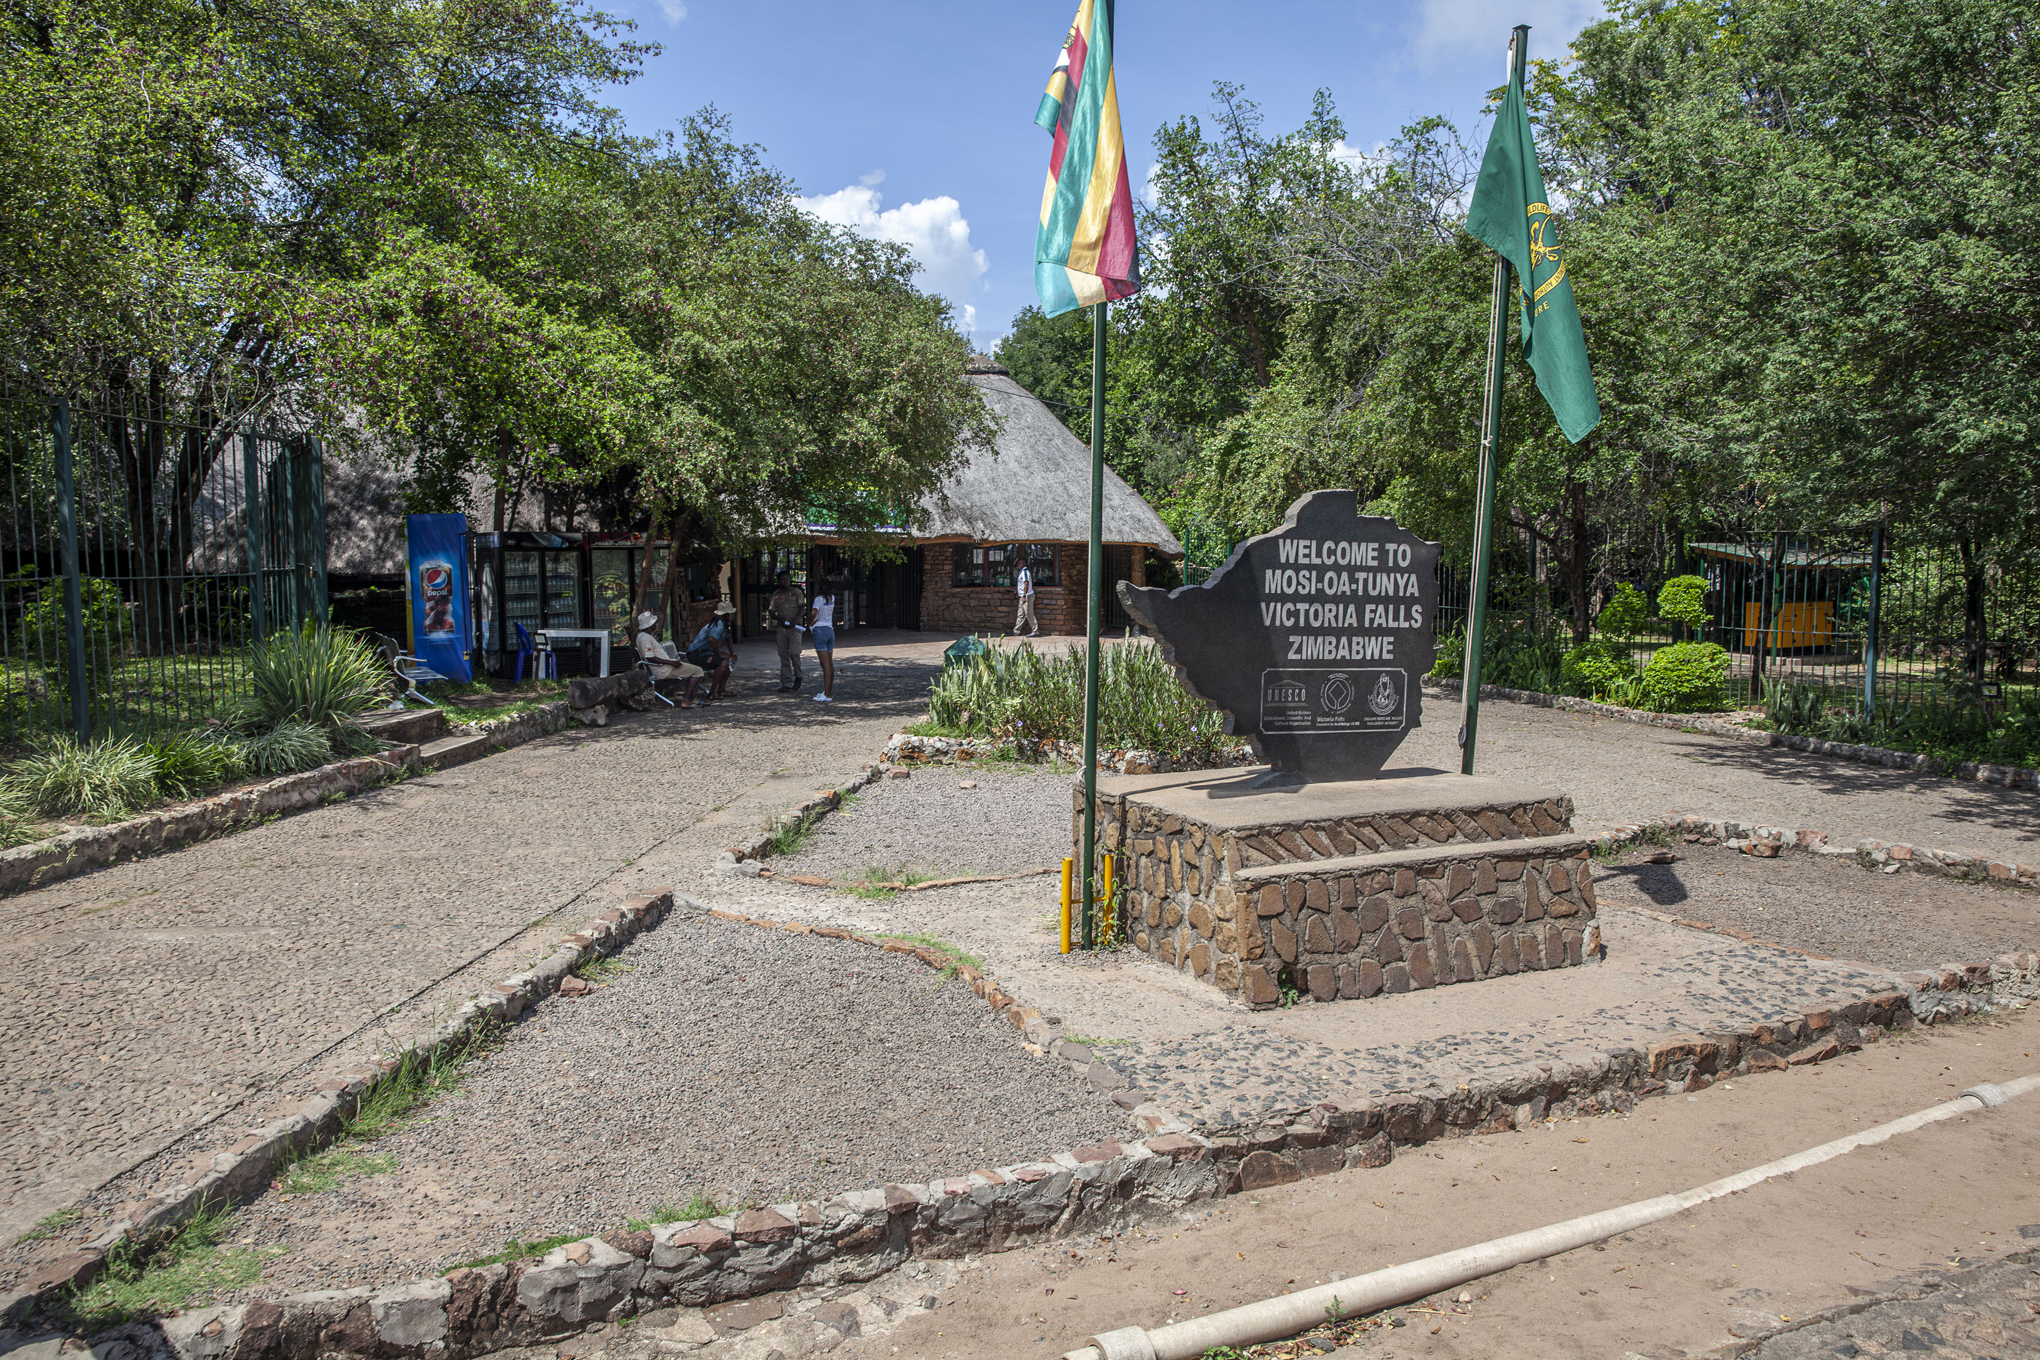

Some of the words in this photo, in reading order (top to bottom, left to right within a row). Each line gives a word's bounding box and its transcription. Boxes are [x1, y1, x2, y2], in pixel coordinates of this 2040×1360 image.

[1279, 538, 1379, 566] WELCOME
[1385, 543, 1412, 567] TO
[428, 589, 448, 597] pepsi
[1265, 569, 1419, 597] MOSI-OA-TUNYA
[1260, 602, 1358, 628] VICTORIA
[1364, 604, 1423, 628] FALLS
[1287, 635, 1394, 660] ZIMBABWE
[1267, 689, 1306, 702] UNESCO
